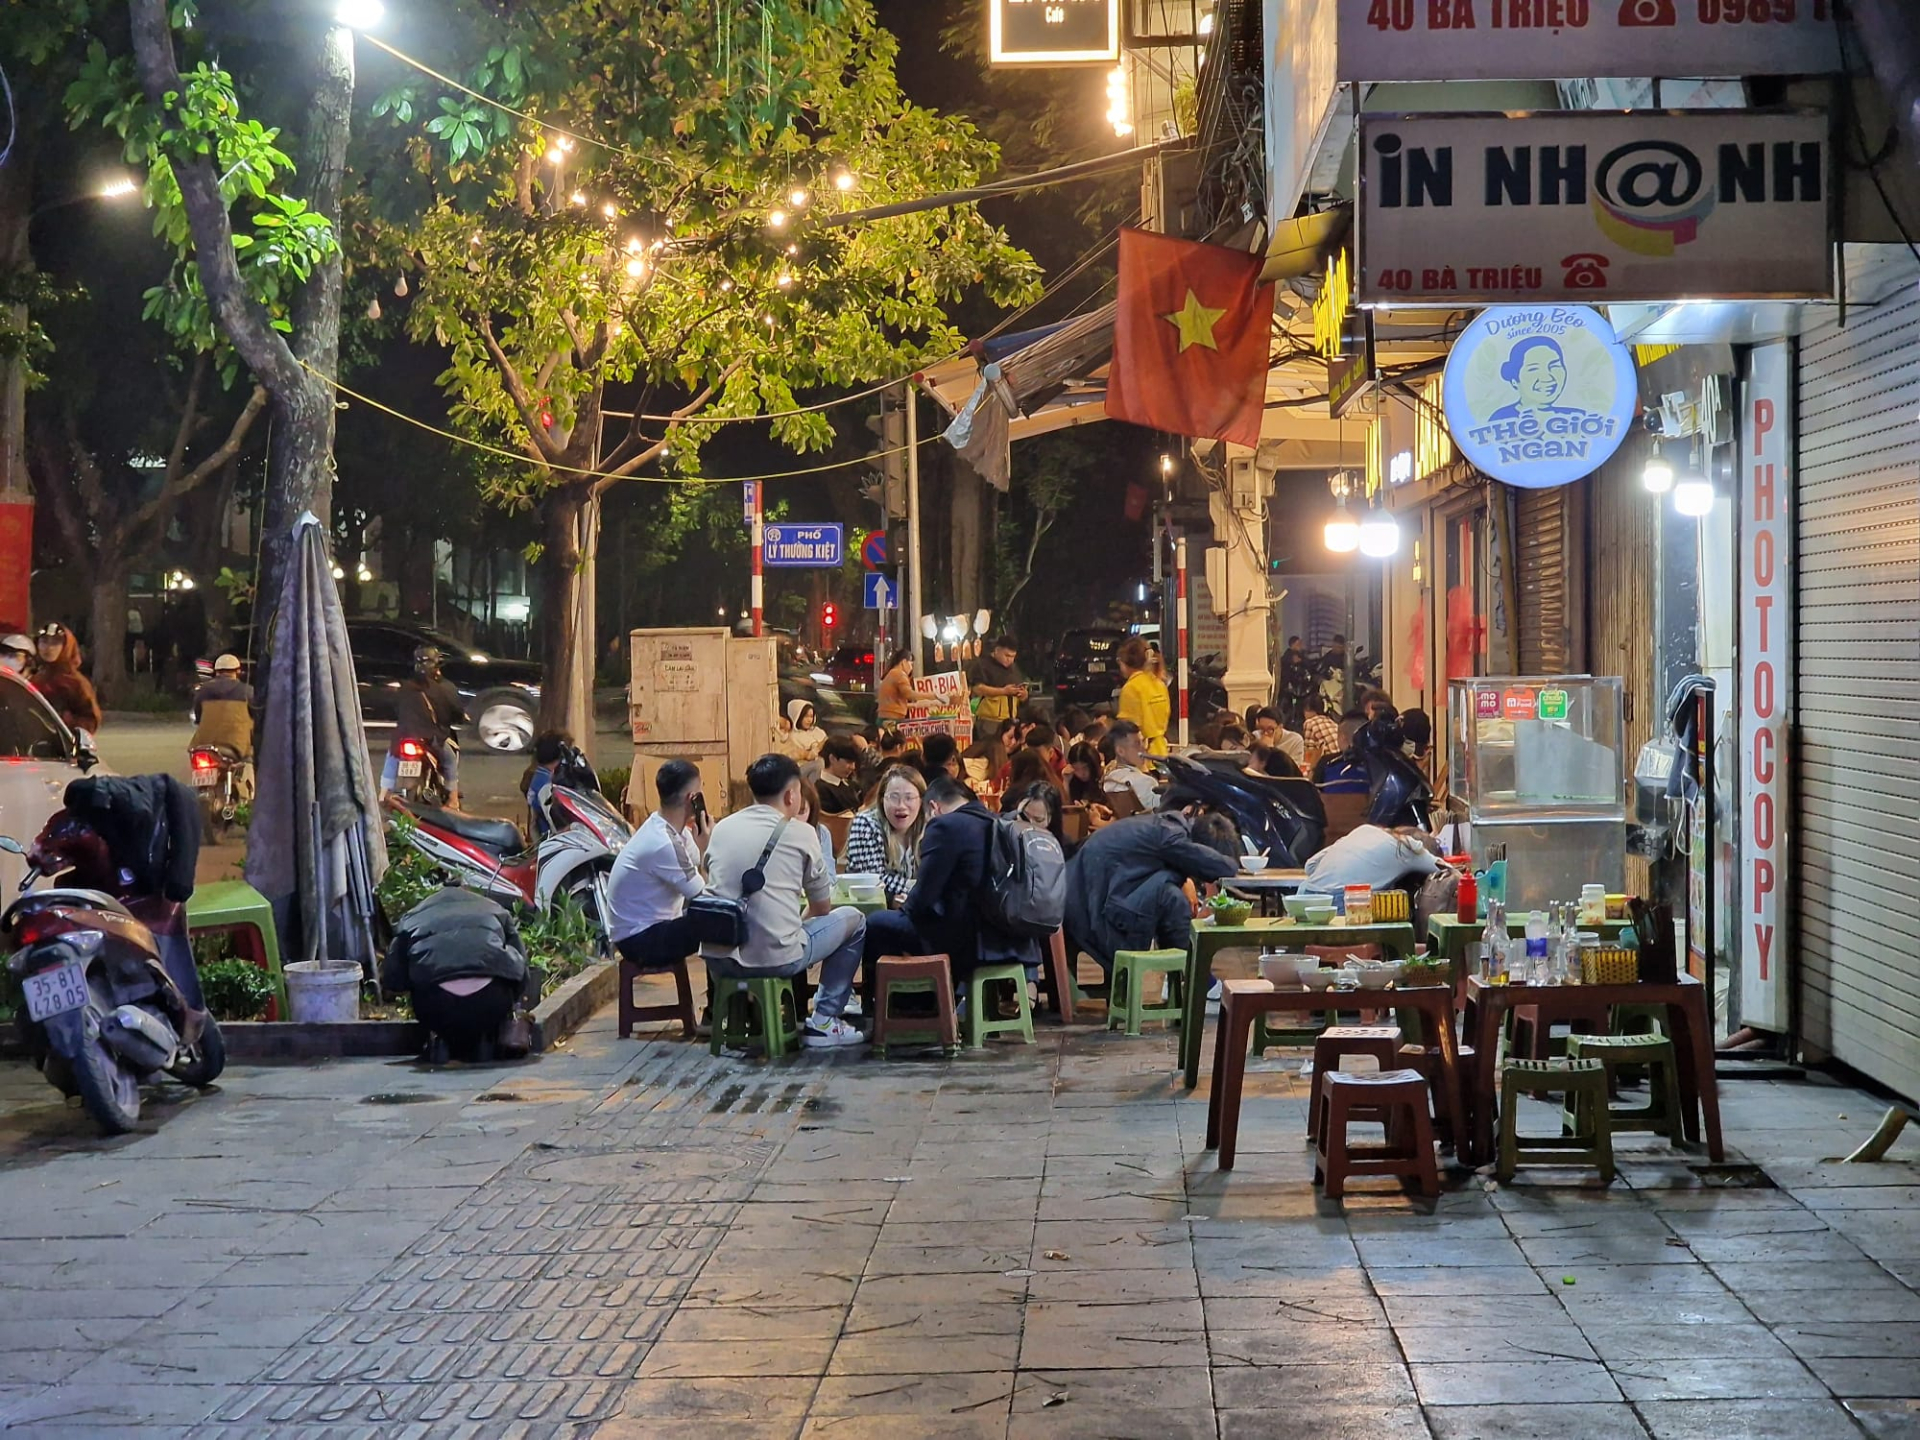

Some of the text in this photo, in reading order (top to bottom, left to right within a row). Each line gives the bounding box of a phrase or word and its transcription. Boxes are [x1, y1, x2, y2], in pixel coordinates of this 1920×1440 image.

[1377, 264, 1542, 293] 40 BÀ TRIỆU
[1484, 308, 1586, 335] Dương Béo
[1507, 323, 1567, 340] since 2005
[797, 528, 823, 540] PHỐ
[768, 541, 835, 561] LÝ THƯỜNG KIỆT
[1753, 399, 1774, 981] PHOTOCOPY
